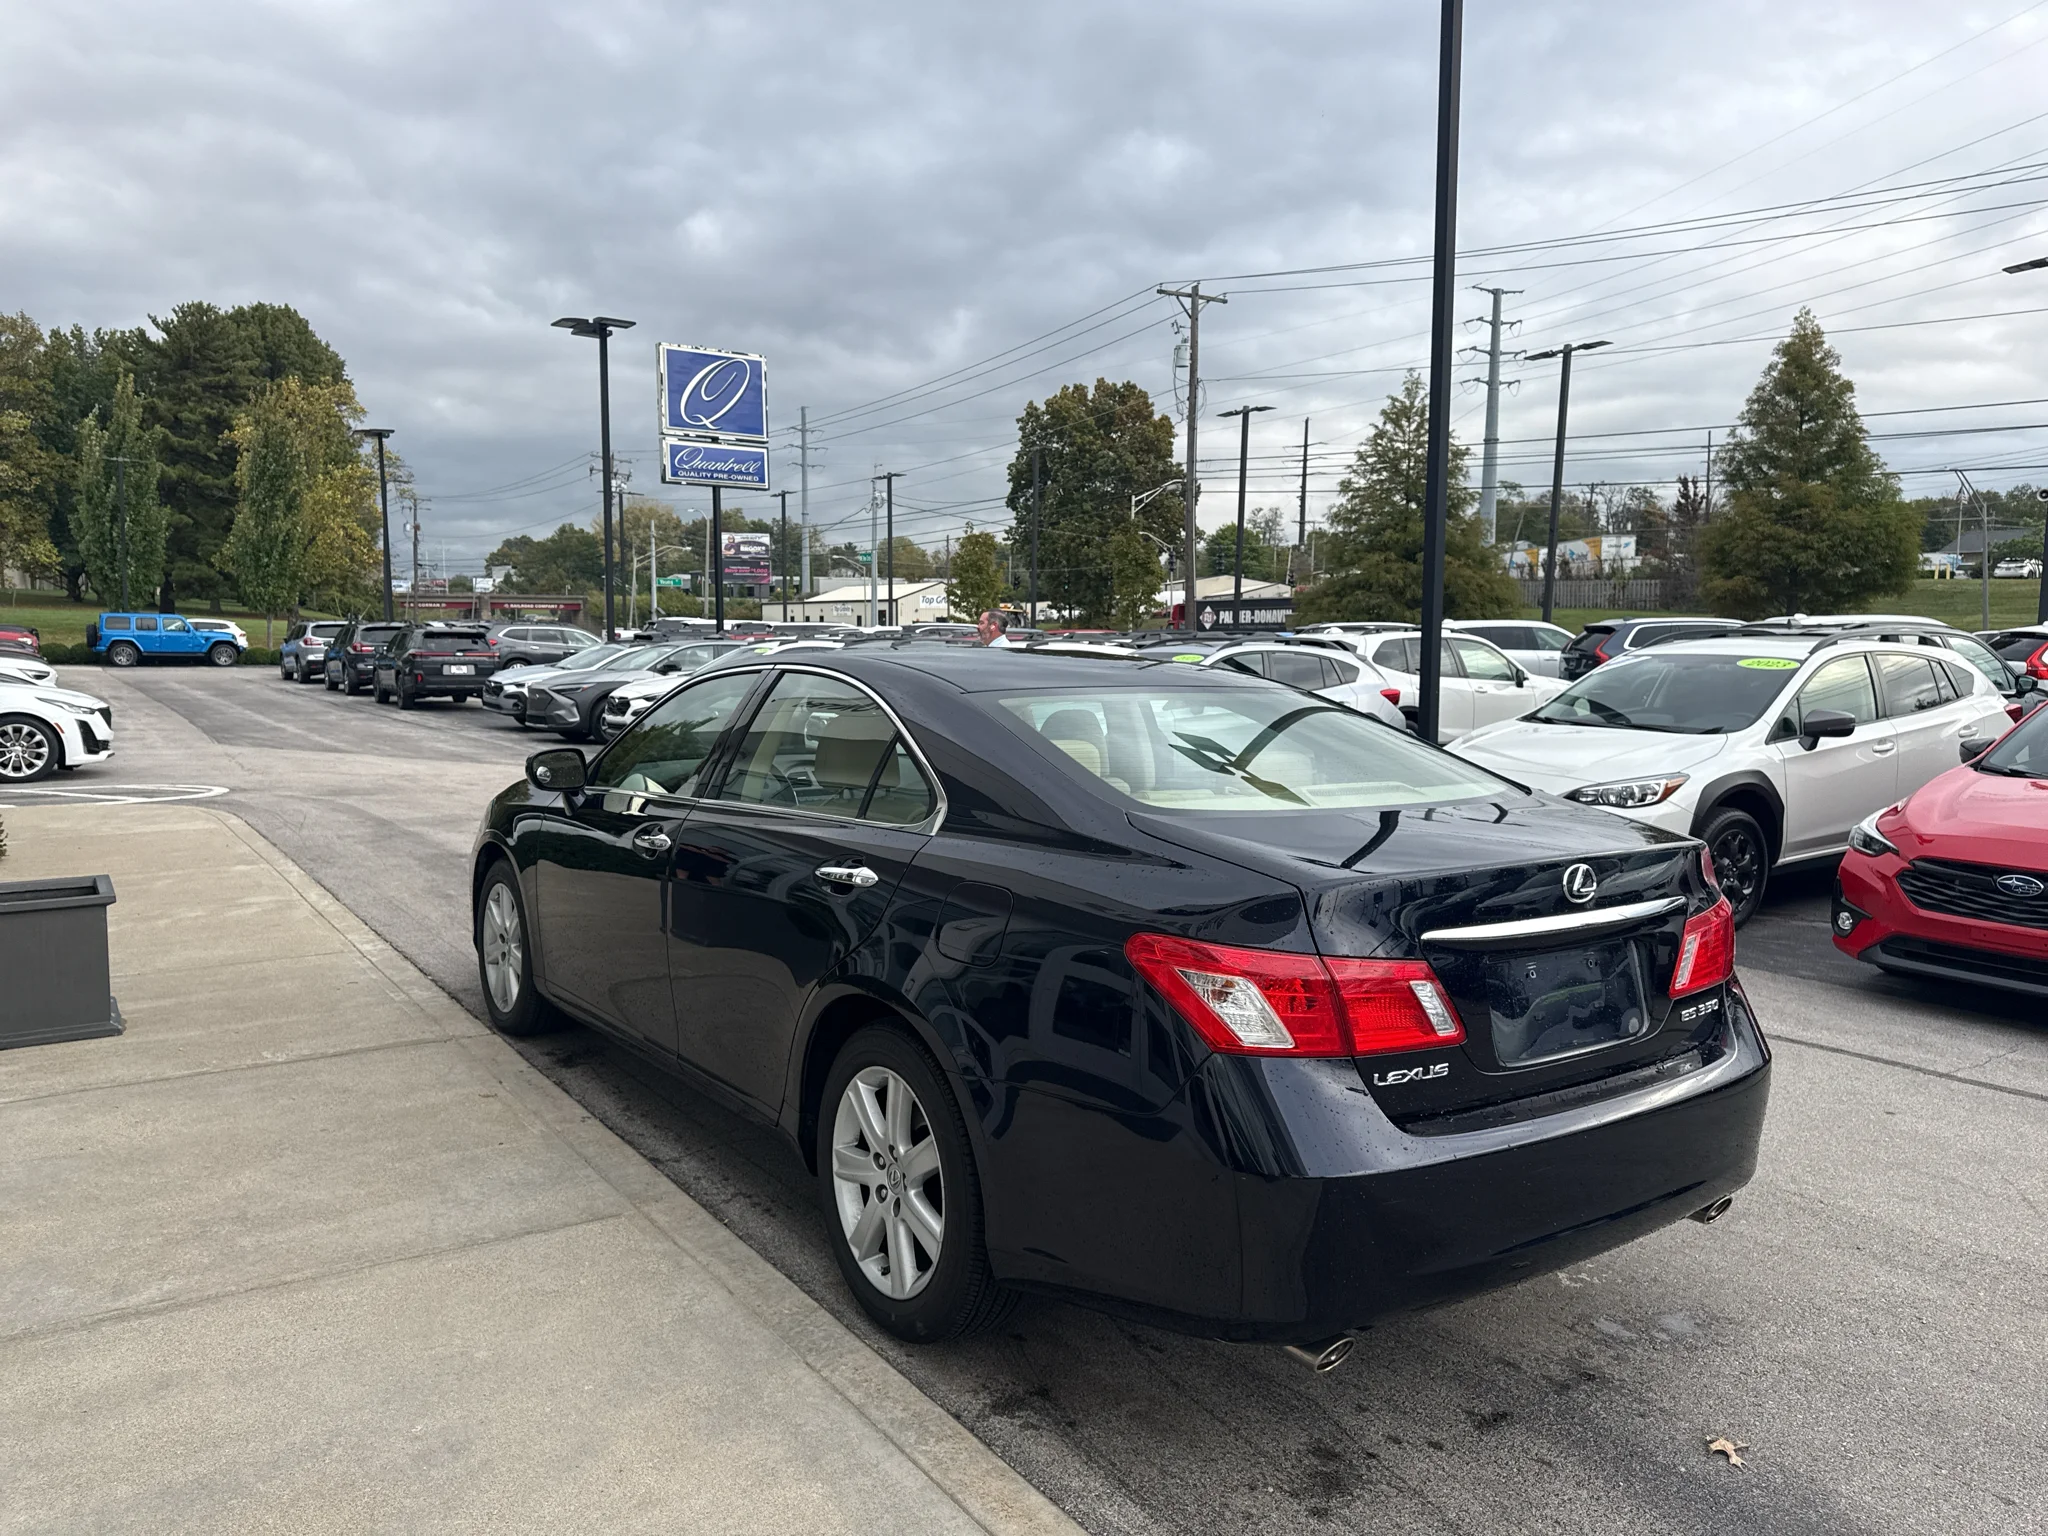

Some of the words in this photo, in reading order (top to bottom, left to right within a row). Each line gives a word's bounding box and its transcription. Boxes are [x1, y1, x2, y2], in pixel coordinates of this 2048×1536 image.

[680, 358, 750, 430] Q
[674, 447, 761, 474] Quantrell
[678, 470, 712, 479] QUALITY
[713, 473, 759, 482] PRE-OWNED
[1681, 1007, 1697, 1021] ES
[1373, 1062, 1450, 1087] LEXUS
